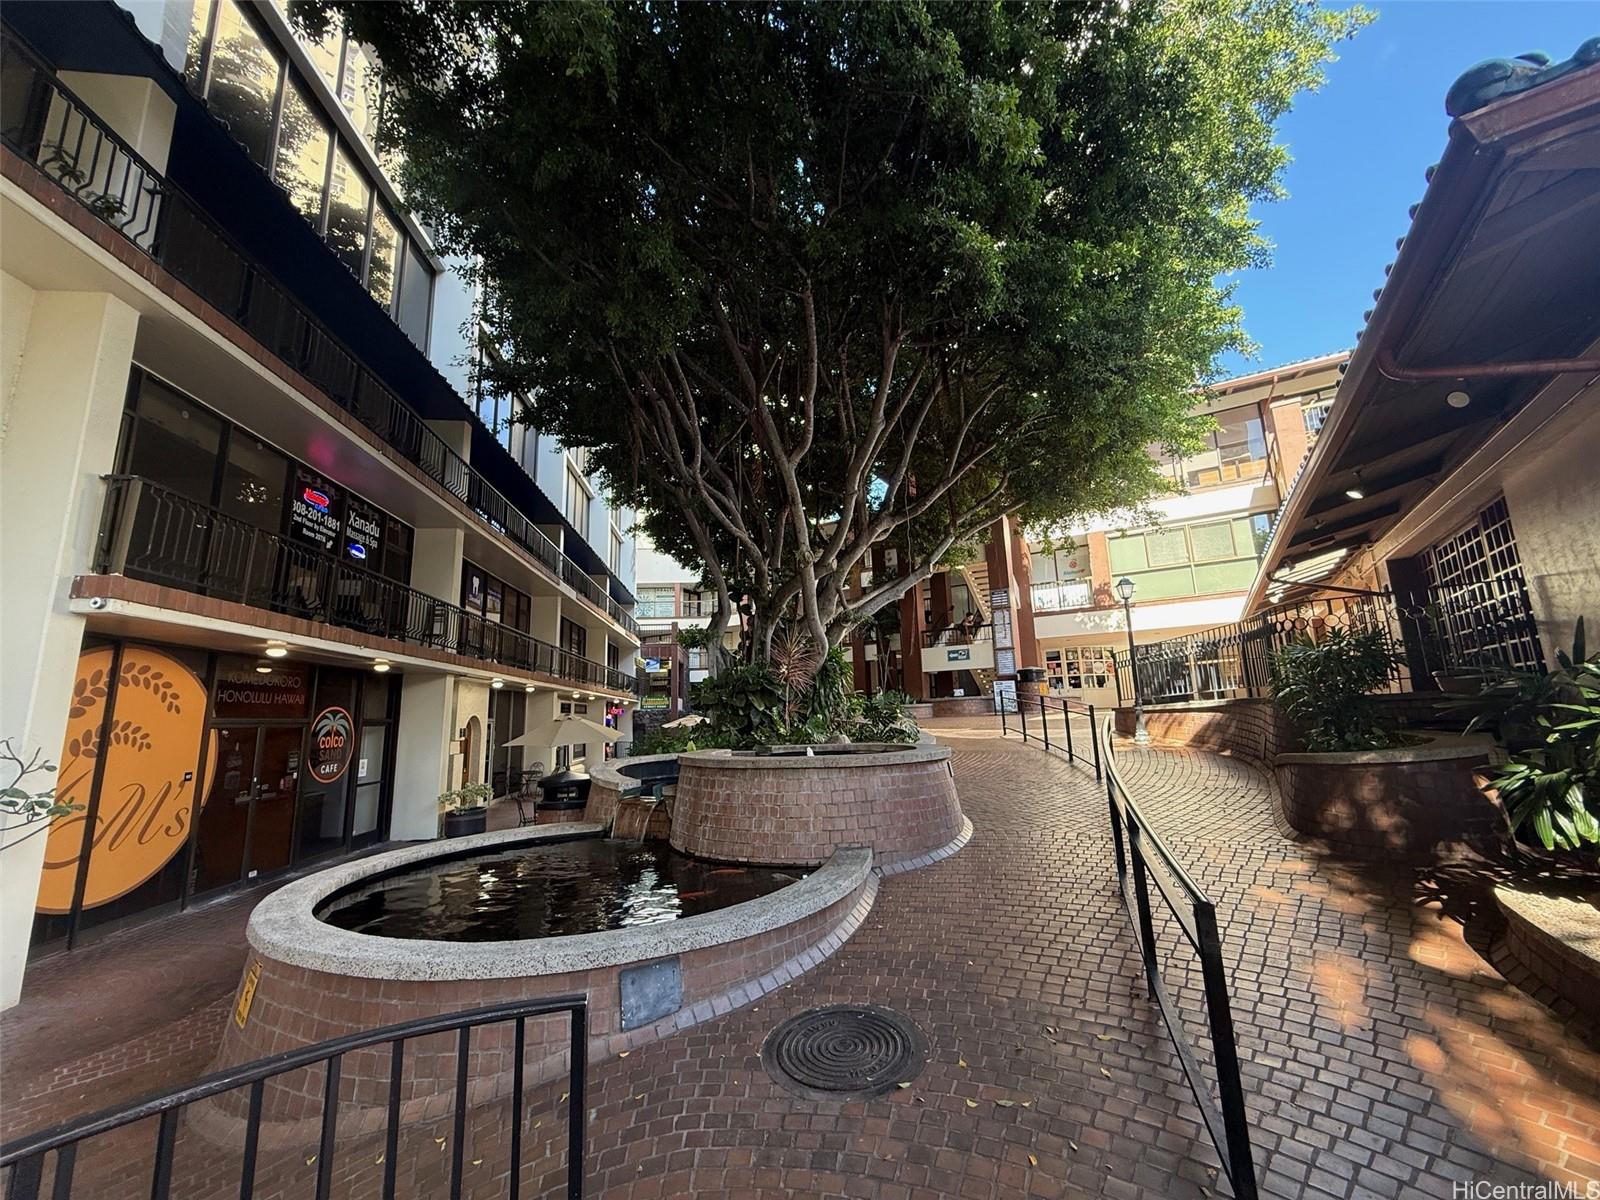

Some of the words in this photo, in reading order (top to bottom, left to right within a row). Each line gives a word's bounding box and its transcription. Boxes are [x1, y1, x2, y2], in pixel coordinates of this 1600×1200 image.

[348, 510, 380, 538] Xanadu
[346, 526, 365, 545] Massage
[369, 536, 378, 550] Spa
[217, 687, 273, 705] HONOLULU
[273, 691, 306, 706] HAWAII
[320, 763, 338, 775] CAFE
